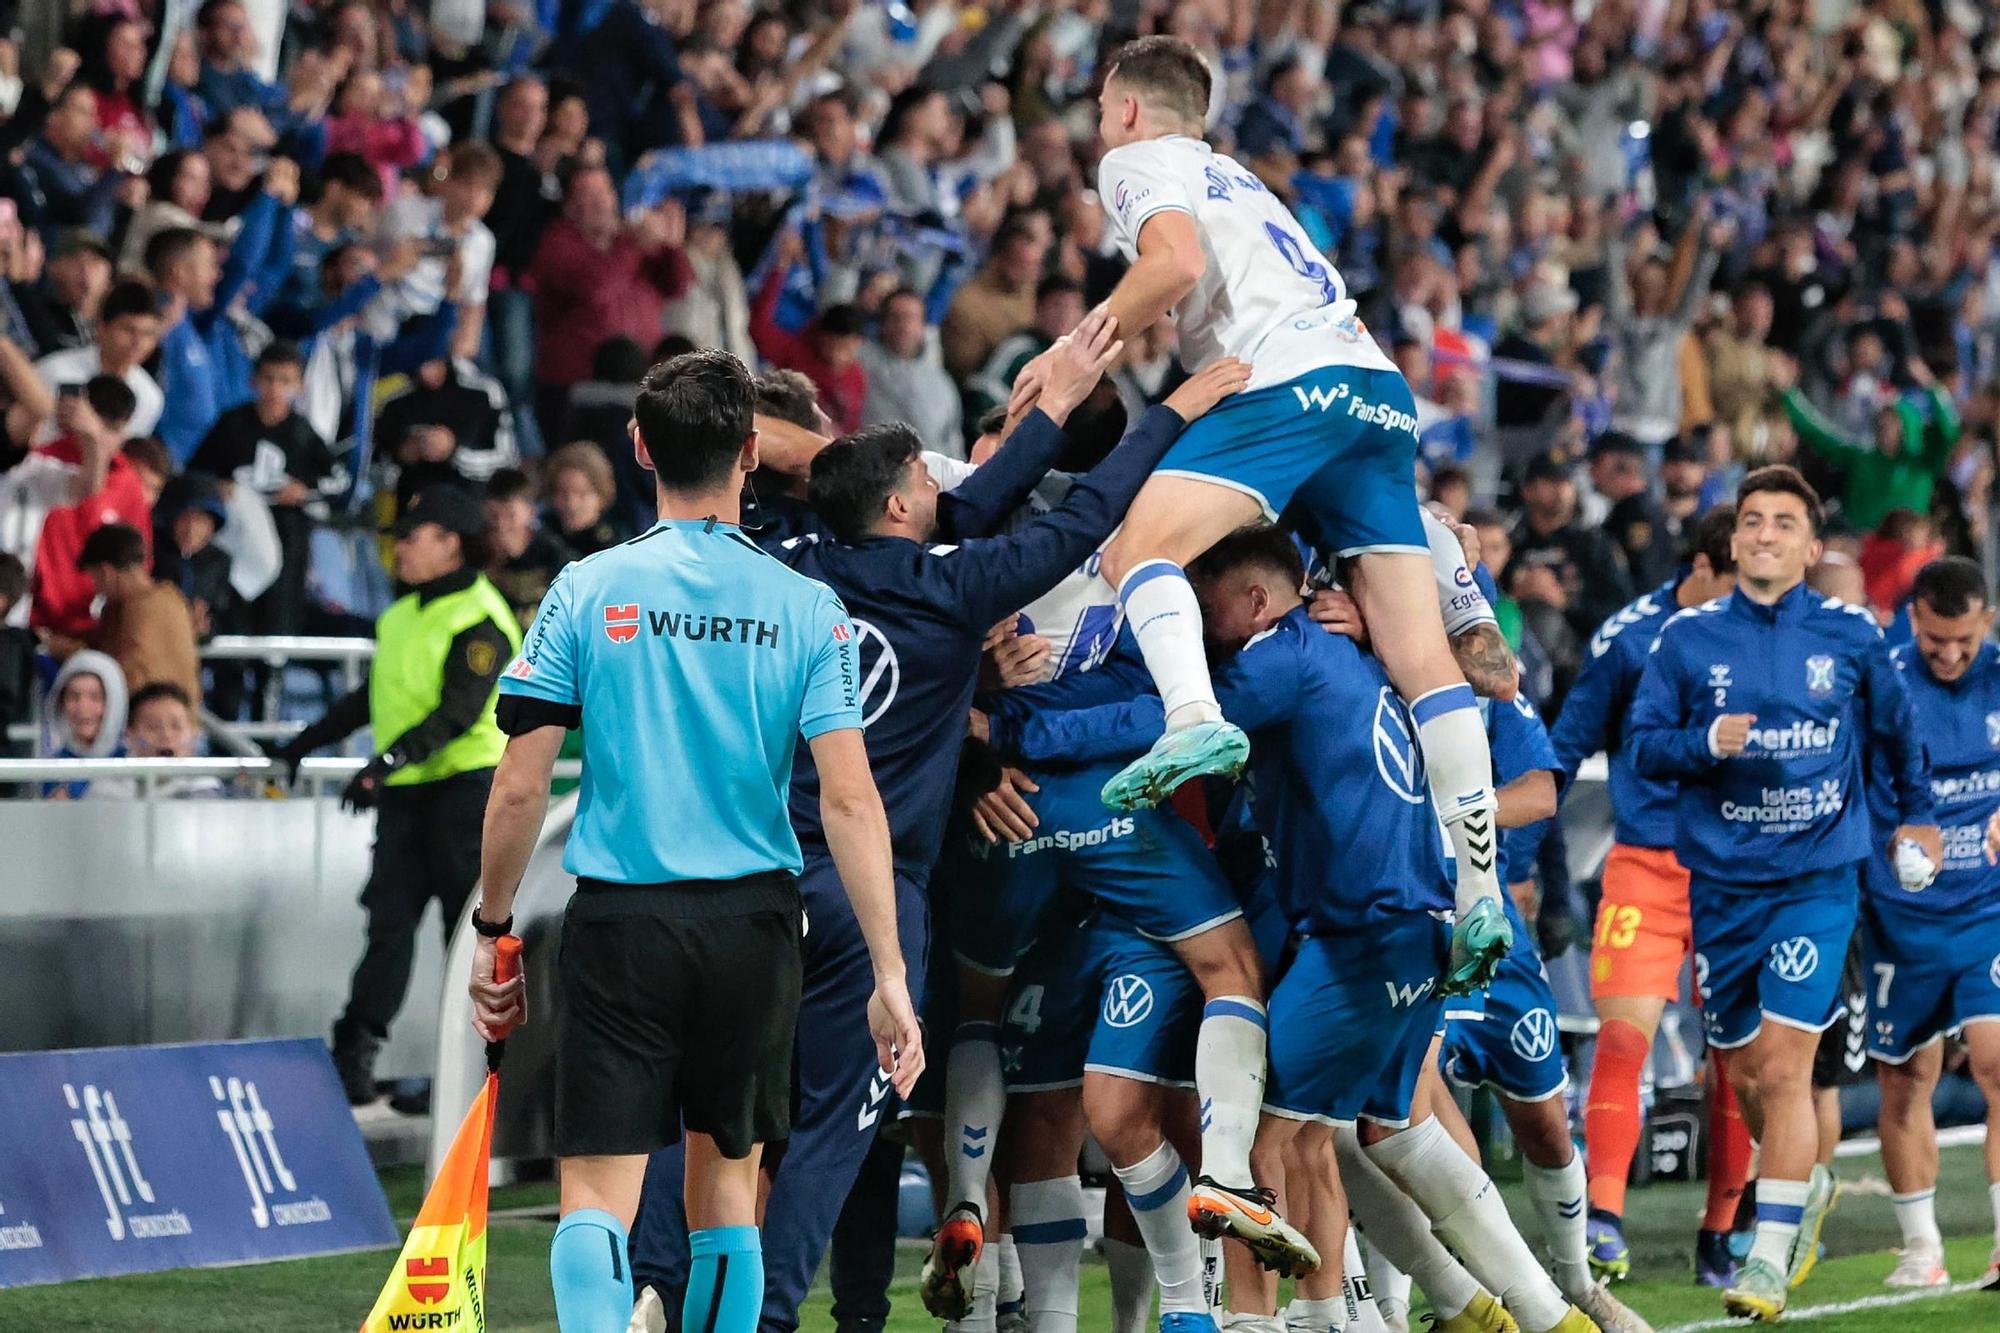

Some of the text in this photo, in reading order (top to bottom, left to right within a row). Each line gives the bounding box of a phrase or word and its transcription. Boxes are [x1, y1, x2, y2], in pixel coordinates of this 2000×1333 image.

[1346, 395, 1421, 443] FanSport
[526, 603, 559, 666] WÜRTH
[647, 610, 780, 650] WÜRTH
[838, 643, 856, 707] WÜRTH
[1720, 800, 1814, 823] Canarias
[1761, 786, 1813, 806] Islas
[1007, 816, 1136, 859] FanSports
[1599, 904, 1643, 949] 13
[1873, 963, 1896, 1008] 7
[1007, 984, 1046, 1034] 4
[388, 1306, 462, 1332] WÜRTH
